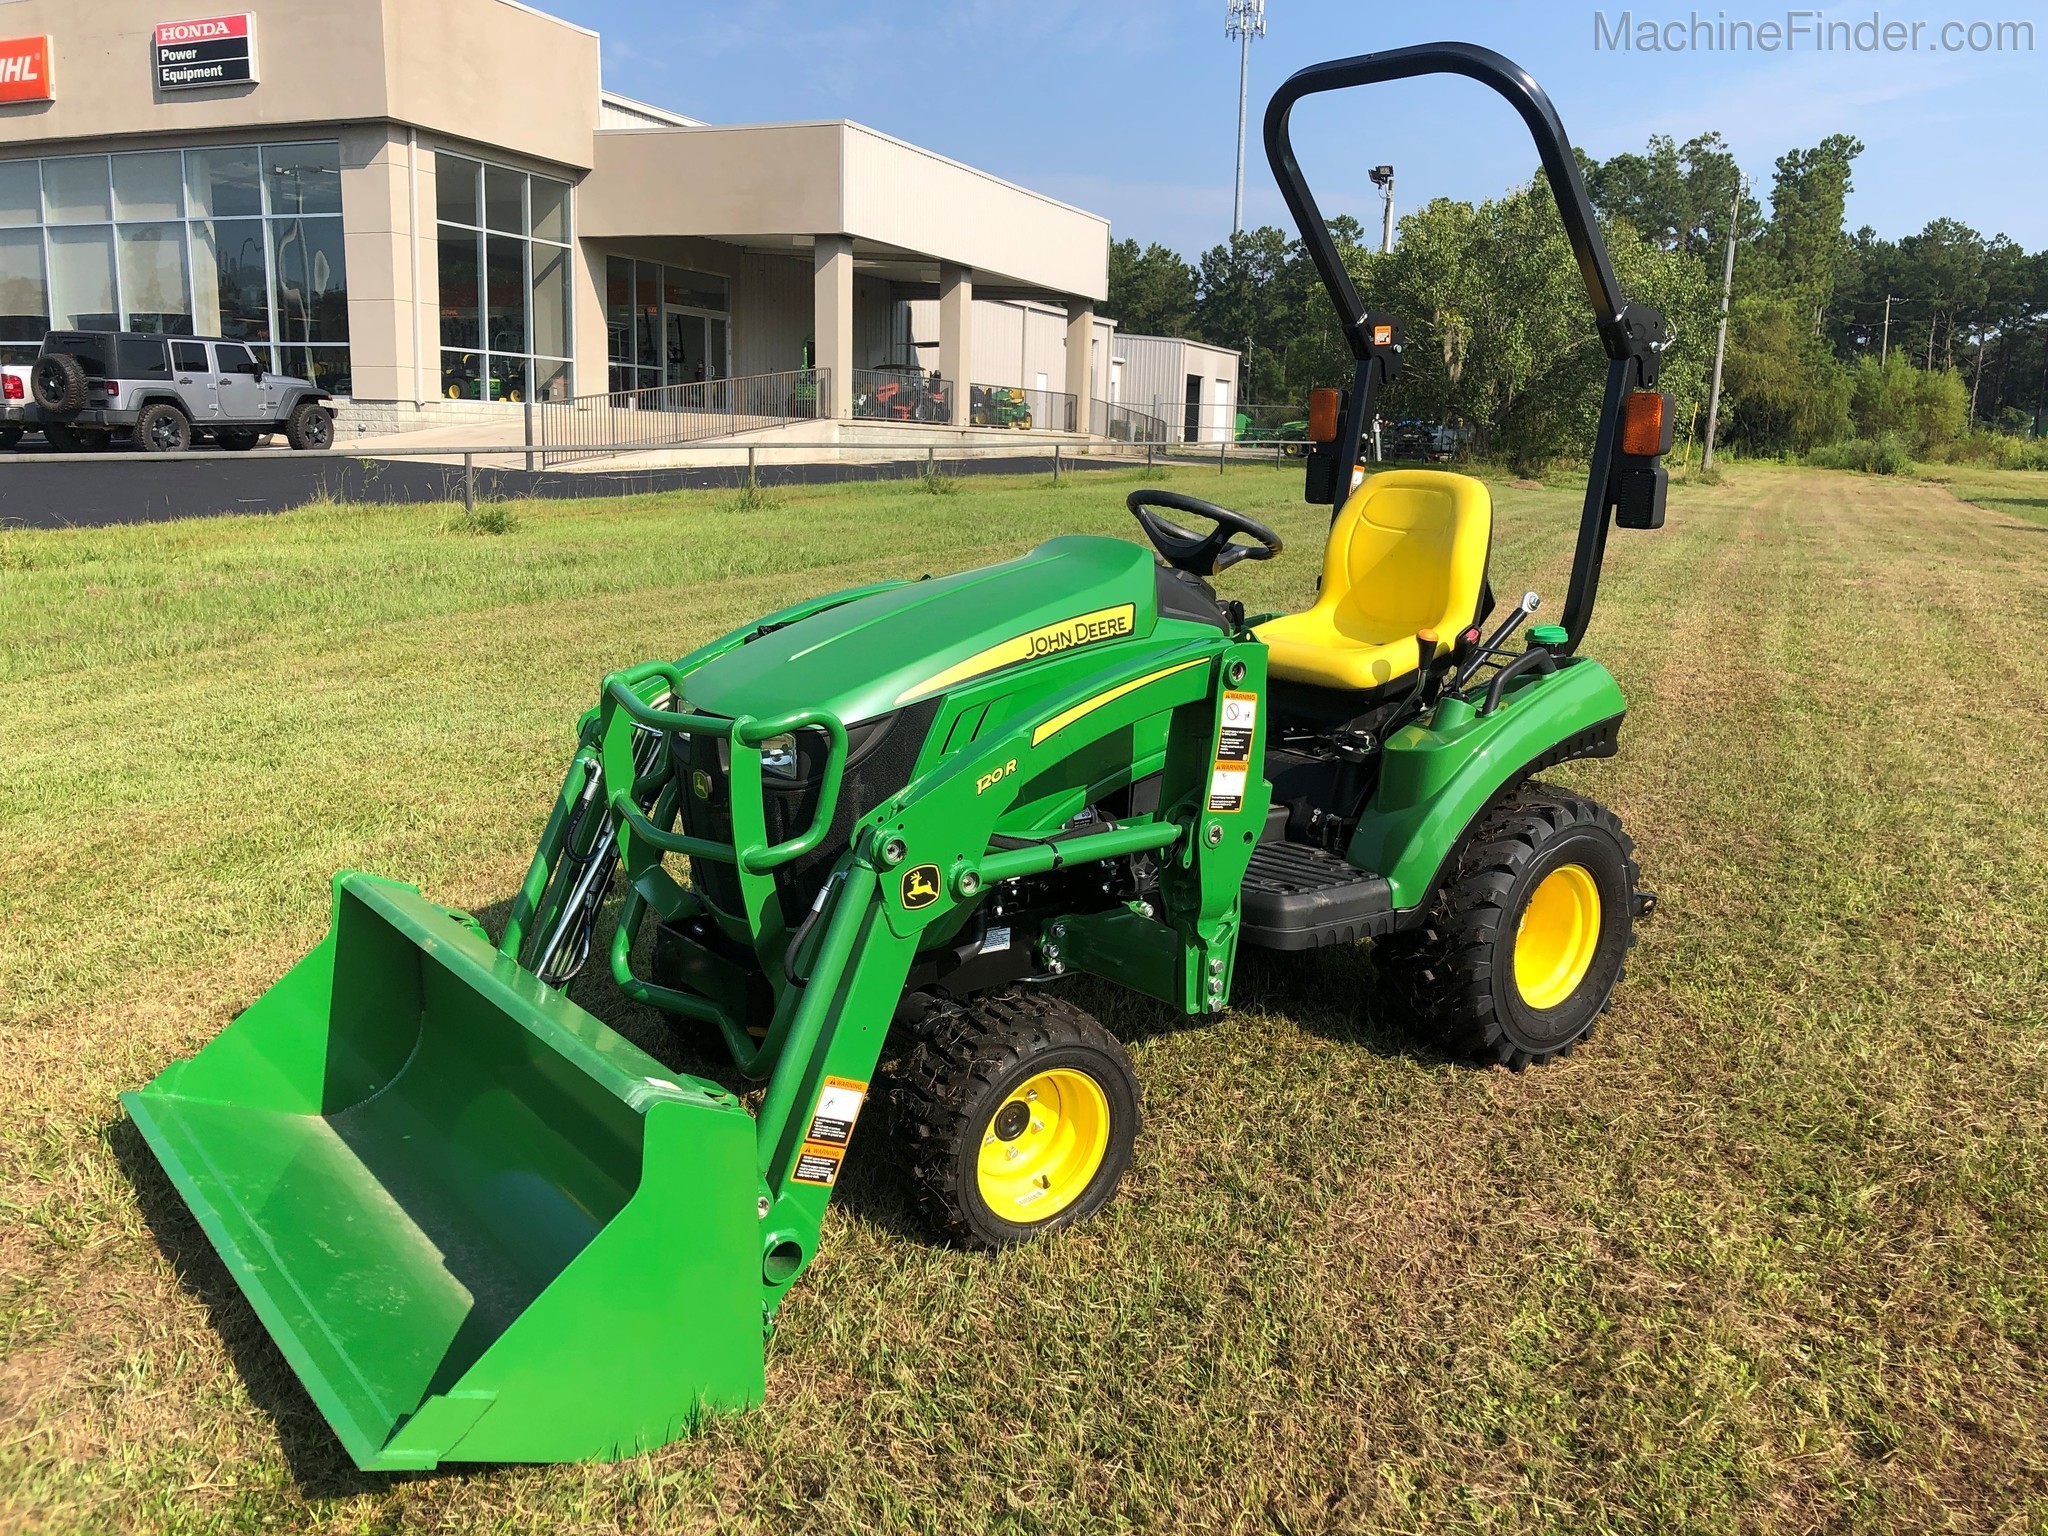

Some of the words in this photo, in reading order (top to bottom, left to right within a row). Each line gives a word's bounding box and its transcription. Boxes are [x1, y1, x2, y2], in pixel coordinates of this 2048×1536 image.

[160, 21, 231, 41] HONDA
[161, 48, 198, 62] Power
[162, 64, 223, 83] Equipment
[1025, 629, 1073, 657] JOHN
[1074, 616, 1127, 642] DEERE
[1005, 758, 1017, 777] R
[836, 1079, 863, 1090] WARNING
[813, 1147, 839, 1157] WARNING
